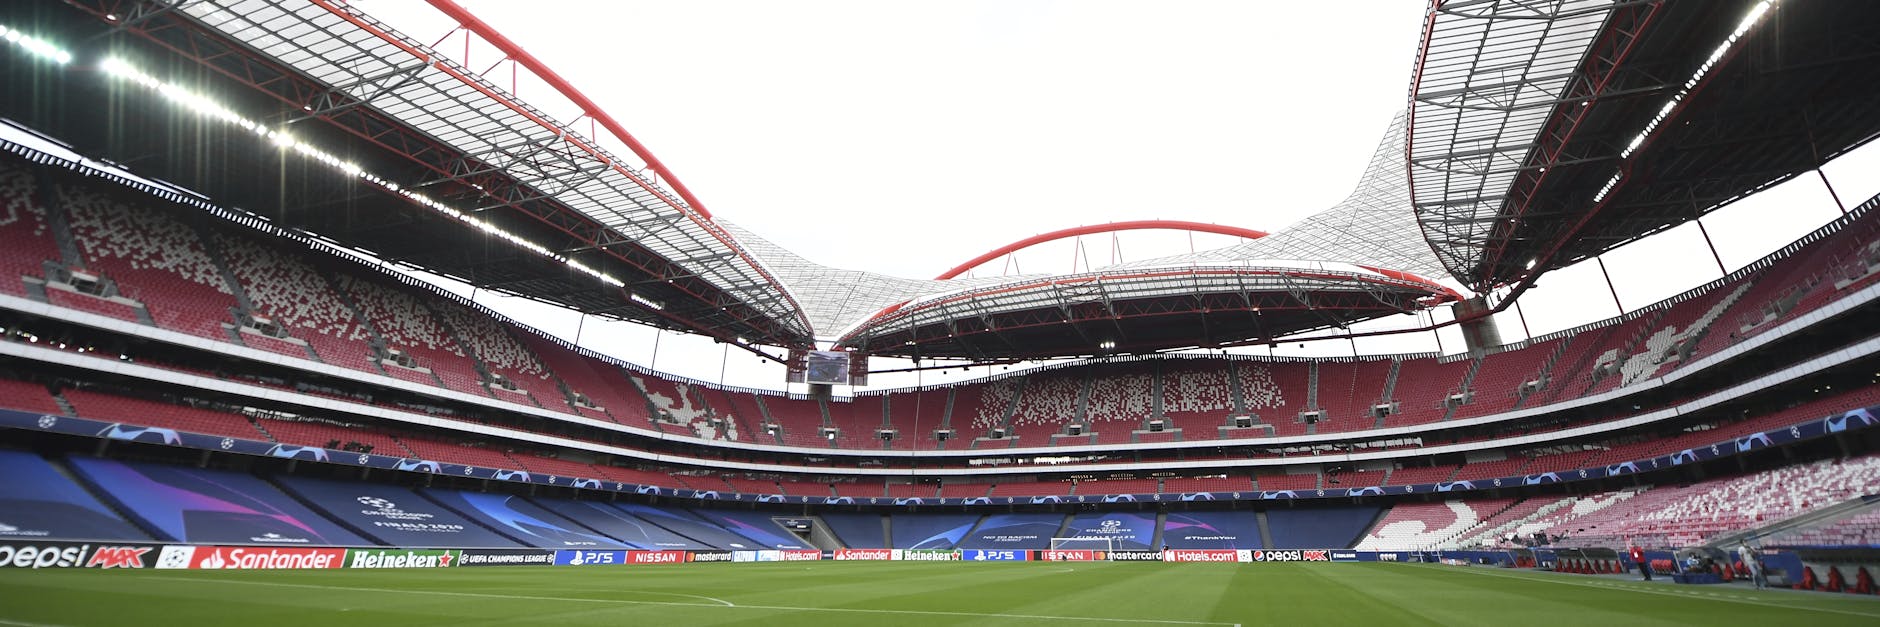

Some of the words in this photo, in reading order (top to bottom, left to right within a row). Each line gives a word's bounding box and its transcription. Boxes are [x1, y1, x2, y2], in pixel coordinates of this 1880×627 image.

[87, 546, 153, 568] MAX
[226, 548, 335, 569] Santander
[350, 550, 438, 569] Heineken
[469, 554, 487, 563] UEFA
[488, 554, 524, 563] CHAMPIONS
[525, 554, 548, 563] LEAGUE
[585, 552, 614, 564] PS5
[635, 552, 677, 563] NISSAN
[695, 550, 732, 562] mastercard
[785, 550, 819, 561] Hotels.com
[846, 550, 889, 561] Santander
[904, 550, 950, 561] Heineken
[987, 551, 1014, 560] PS5
[1041, 551, 1083, 561] ISSAN
[1107, 550, 1162, 561] mastercard
[1178, 550, 1234, 562] Hotels.com
[1266, 550, 1301, 562] pepsi
[1303, 550, 1330, 561] MAX
